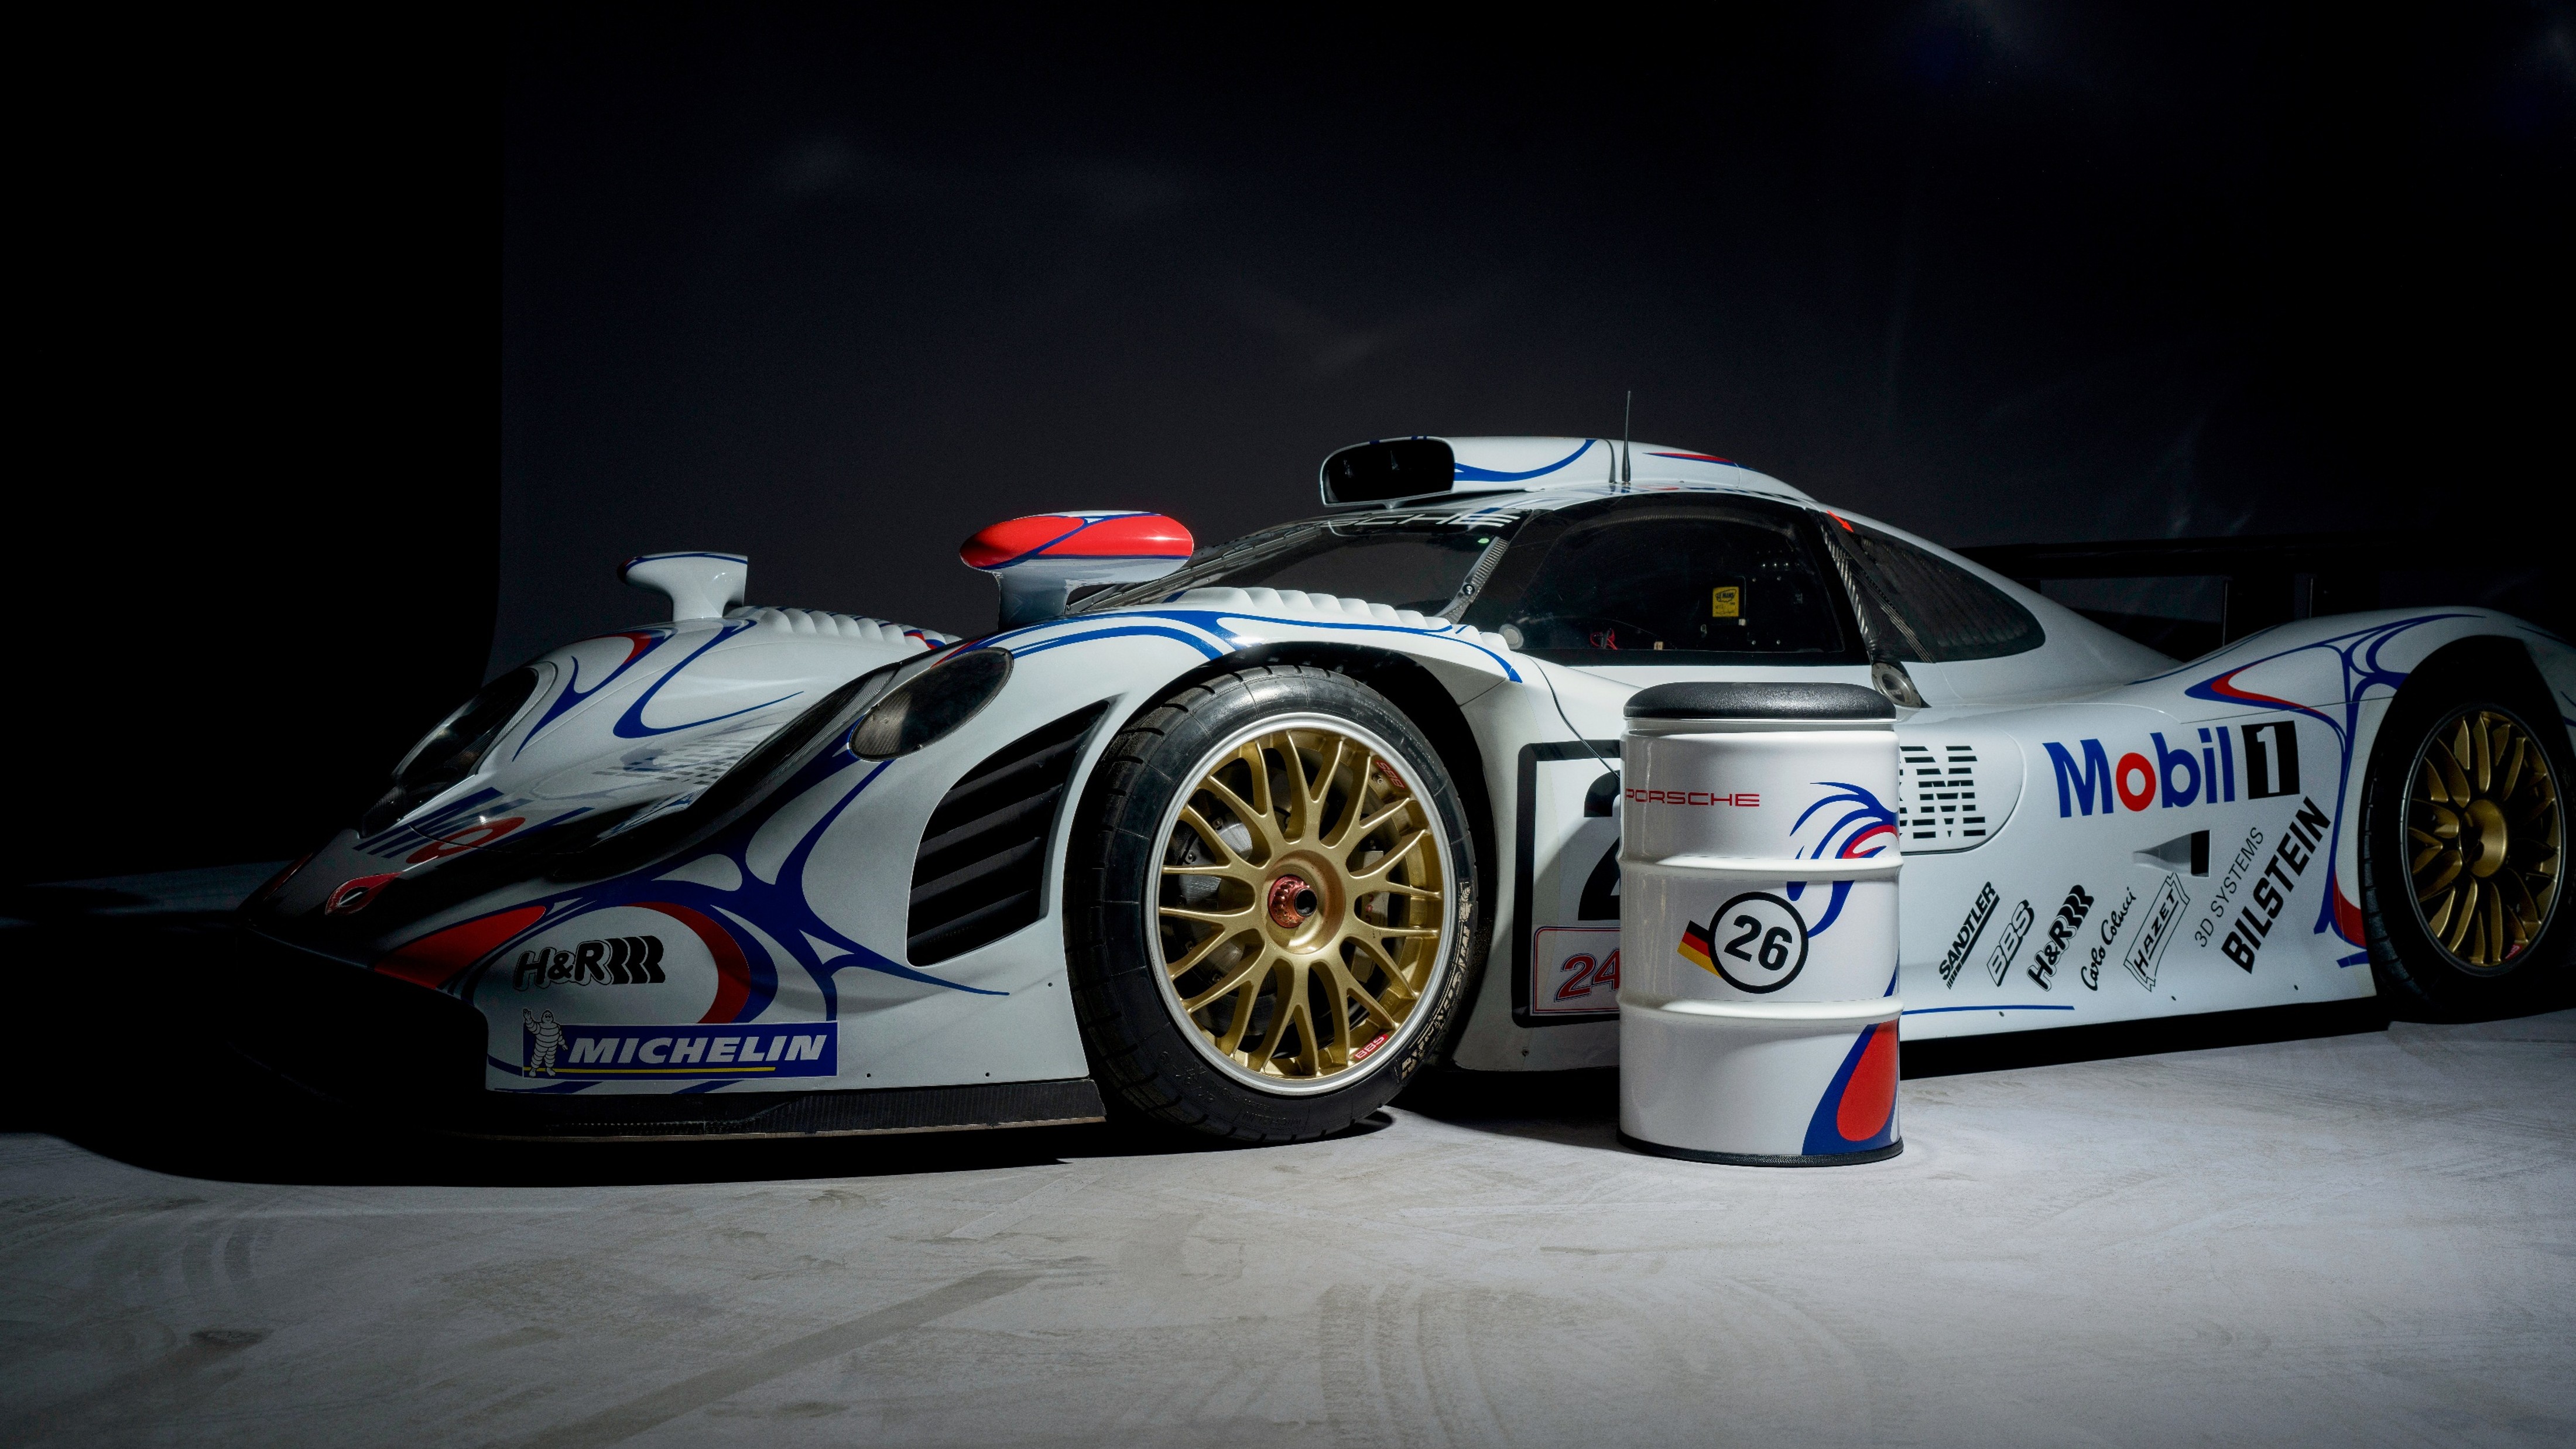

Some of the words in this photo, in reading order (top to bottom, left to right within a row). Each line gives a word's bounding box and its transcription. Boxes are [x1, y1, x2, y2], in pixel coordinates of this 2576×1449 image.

[1376, 761, 1405, 789] BBS
[1625, 788, 1760, 807] PORSCHE
[2043, 725, 2235, 818] Mobil
[2194, 921, 2215, 948] 3D
[2211, 826, 2265, 919] SYSTEMS
[2221, 796, 2331, 974] BILSTEIN
[1724, 914, 1793, 971] 26
[1938, 881, 1998, 981] SANDTLER
[1987, 899, 2035, 987] BBS
[2132, 890, 2179, 978] HAZET
[568, 1034, 827, 1064] MICHELIN
[1354, 1036, 1385, 1059] BBS
